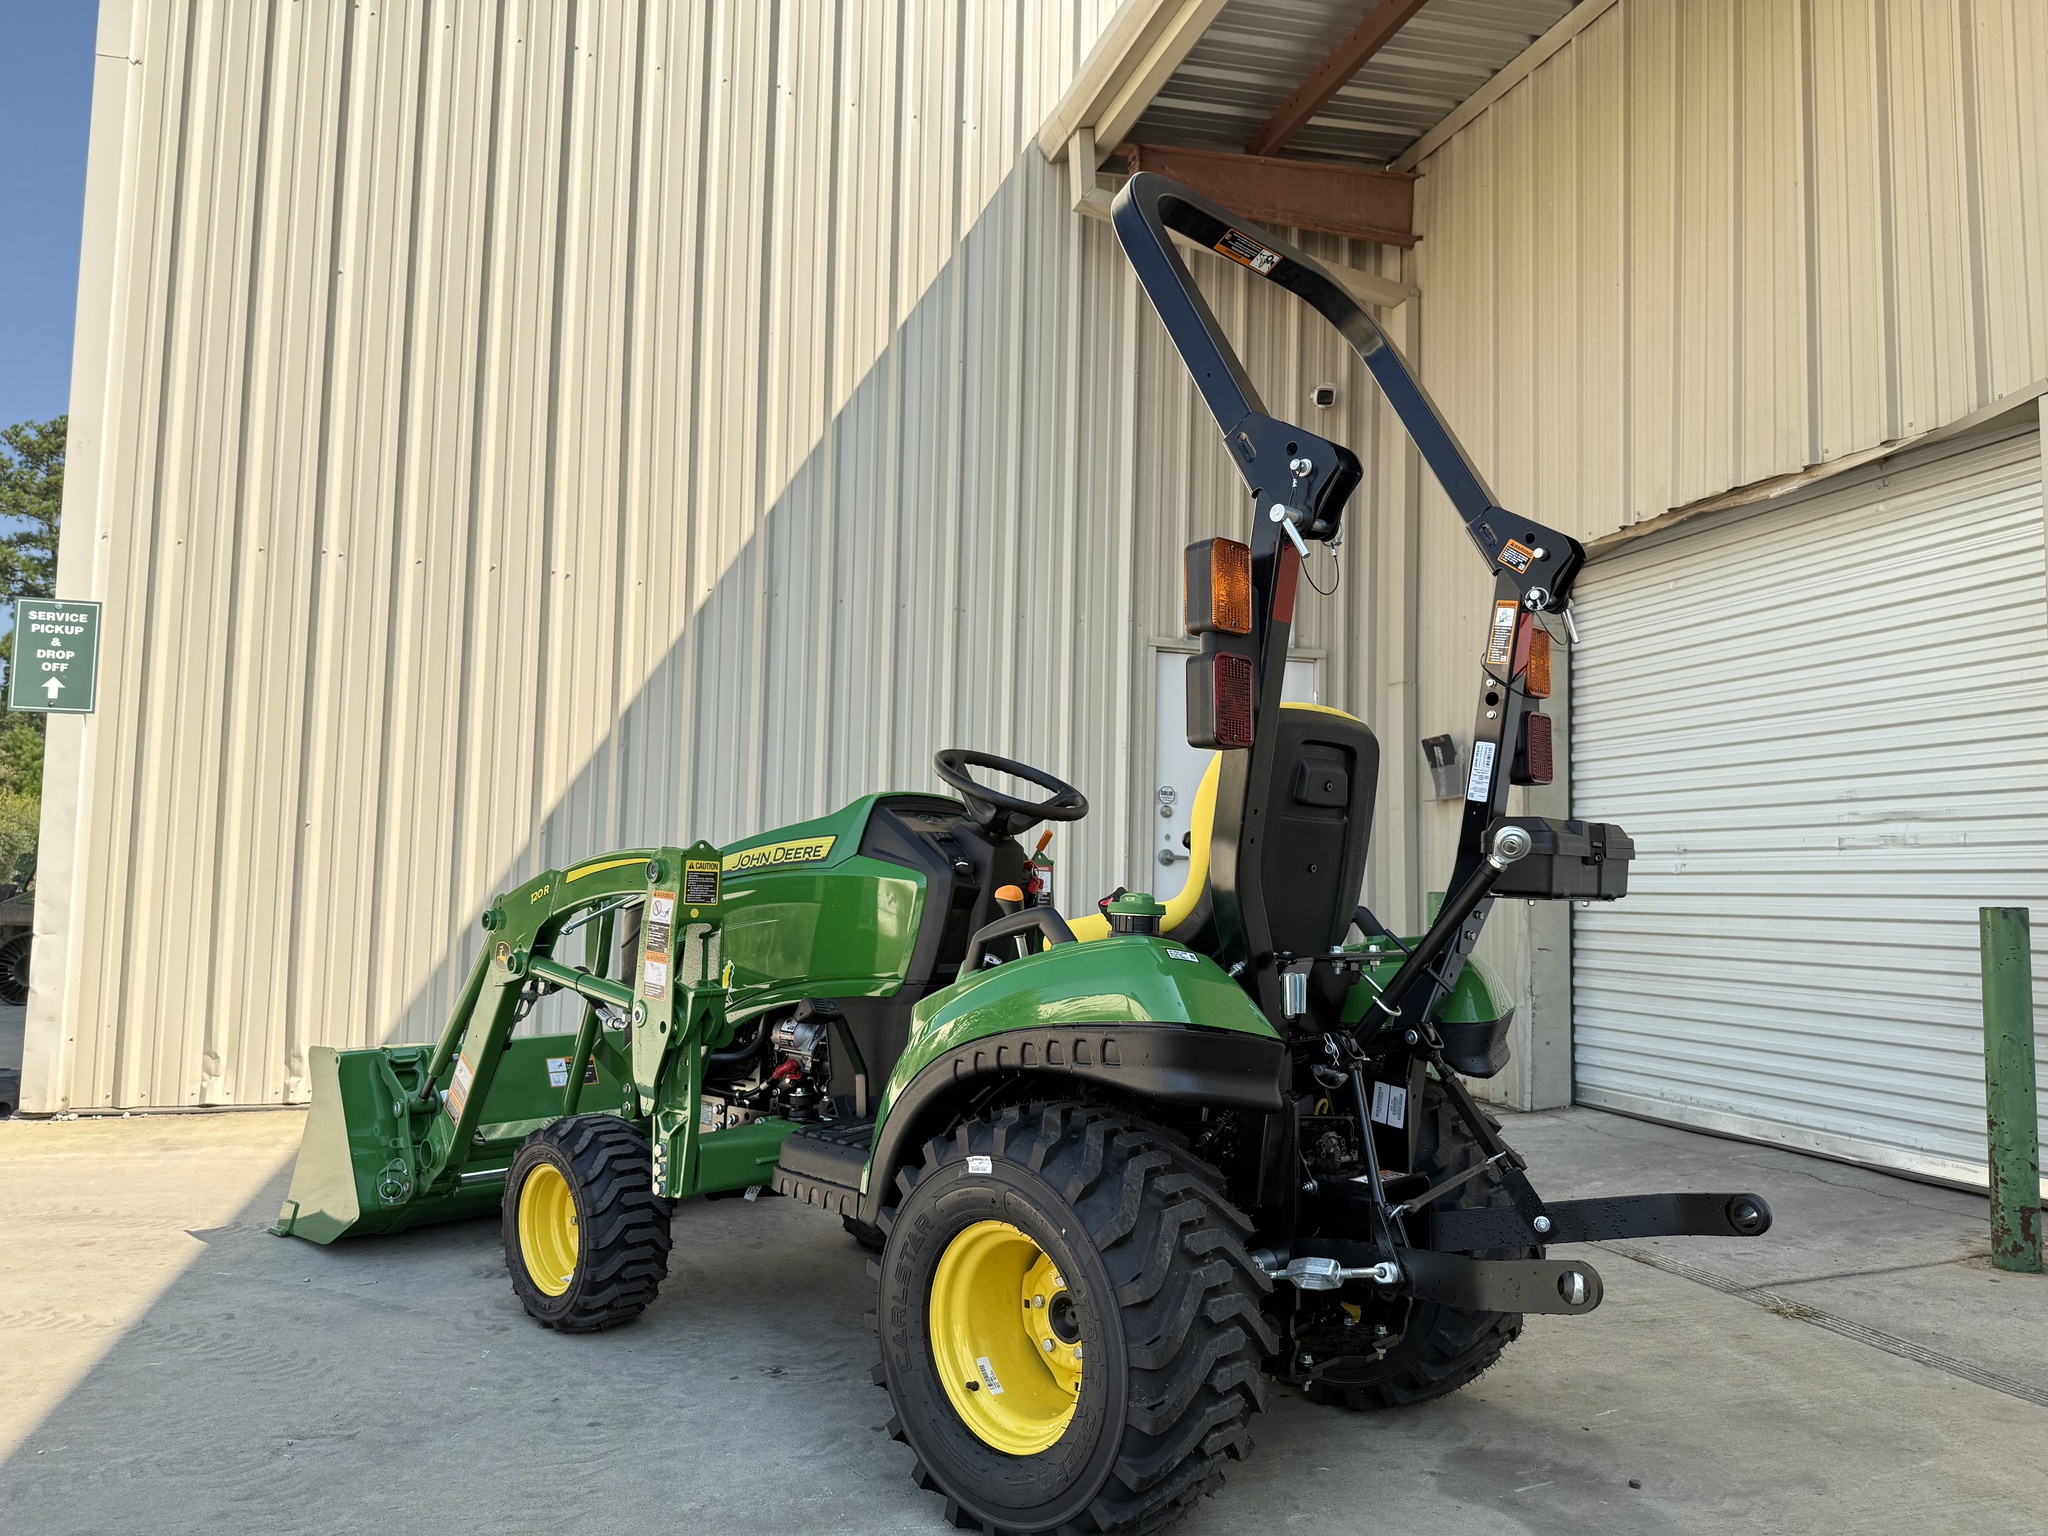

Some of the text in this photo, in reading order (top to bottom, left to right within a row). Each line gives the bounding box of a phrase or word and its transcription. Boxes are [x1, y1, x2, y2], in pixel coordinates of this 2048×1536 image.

[28, 610, 88, 623] SERVICE
[31, 623, 84, 635] PICKUP
[51, 637, 62, 647] &
[36, 649, 75, 660] DROP
[41, 662, 69, 672] OFF
[732, 845, 824, 869] JOHN DEERE
[695, 862, 719, 870] CAUTION
[891, 1212, 934, 1373] CARLSTAR
[1056, 1299, 1101, 1486] TRAC CHIEF
